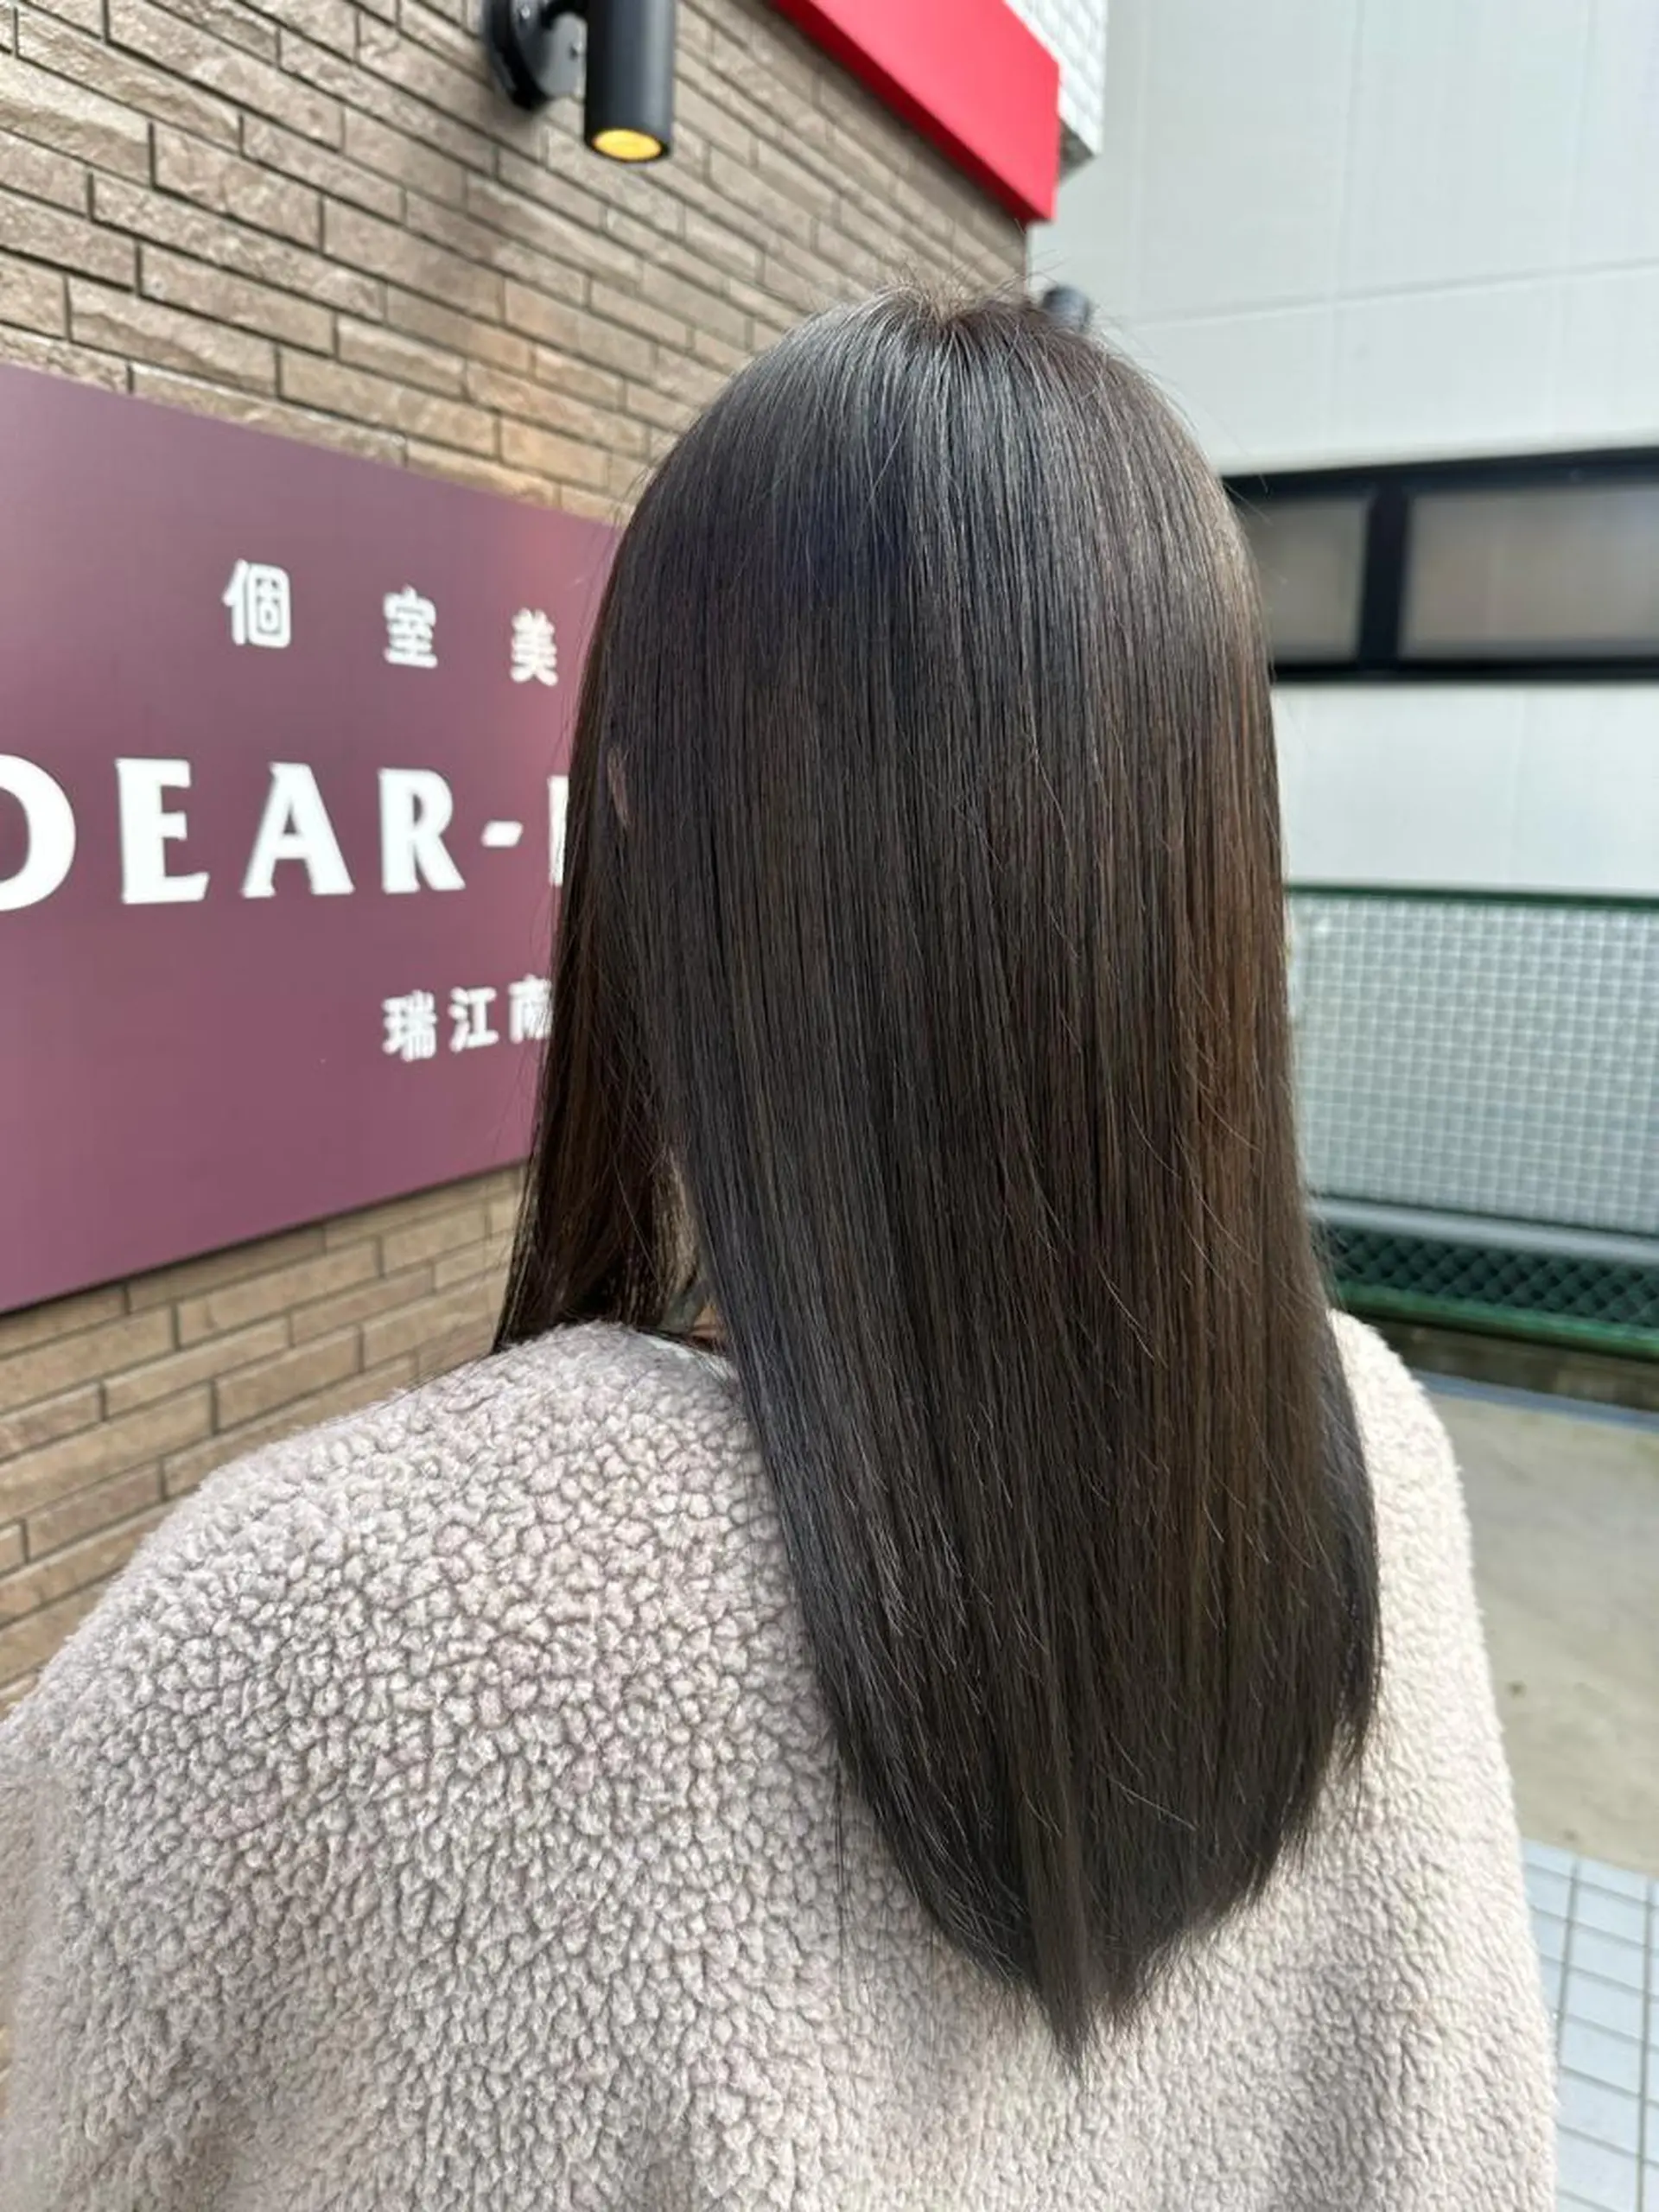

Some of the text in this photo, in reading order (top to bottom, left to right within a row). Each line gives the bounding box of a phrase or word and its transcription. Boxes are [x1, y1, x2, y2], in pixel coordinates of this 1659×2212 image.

[221, 558, 559, 687] 個室美
[0, 753, 569, 912] DEAR-
